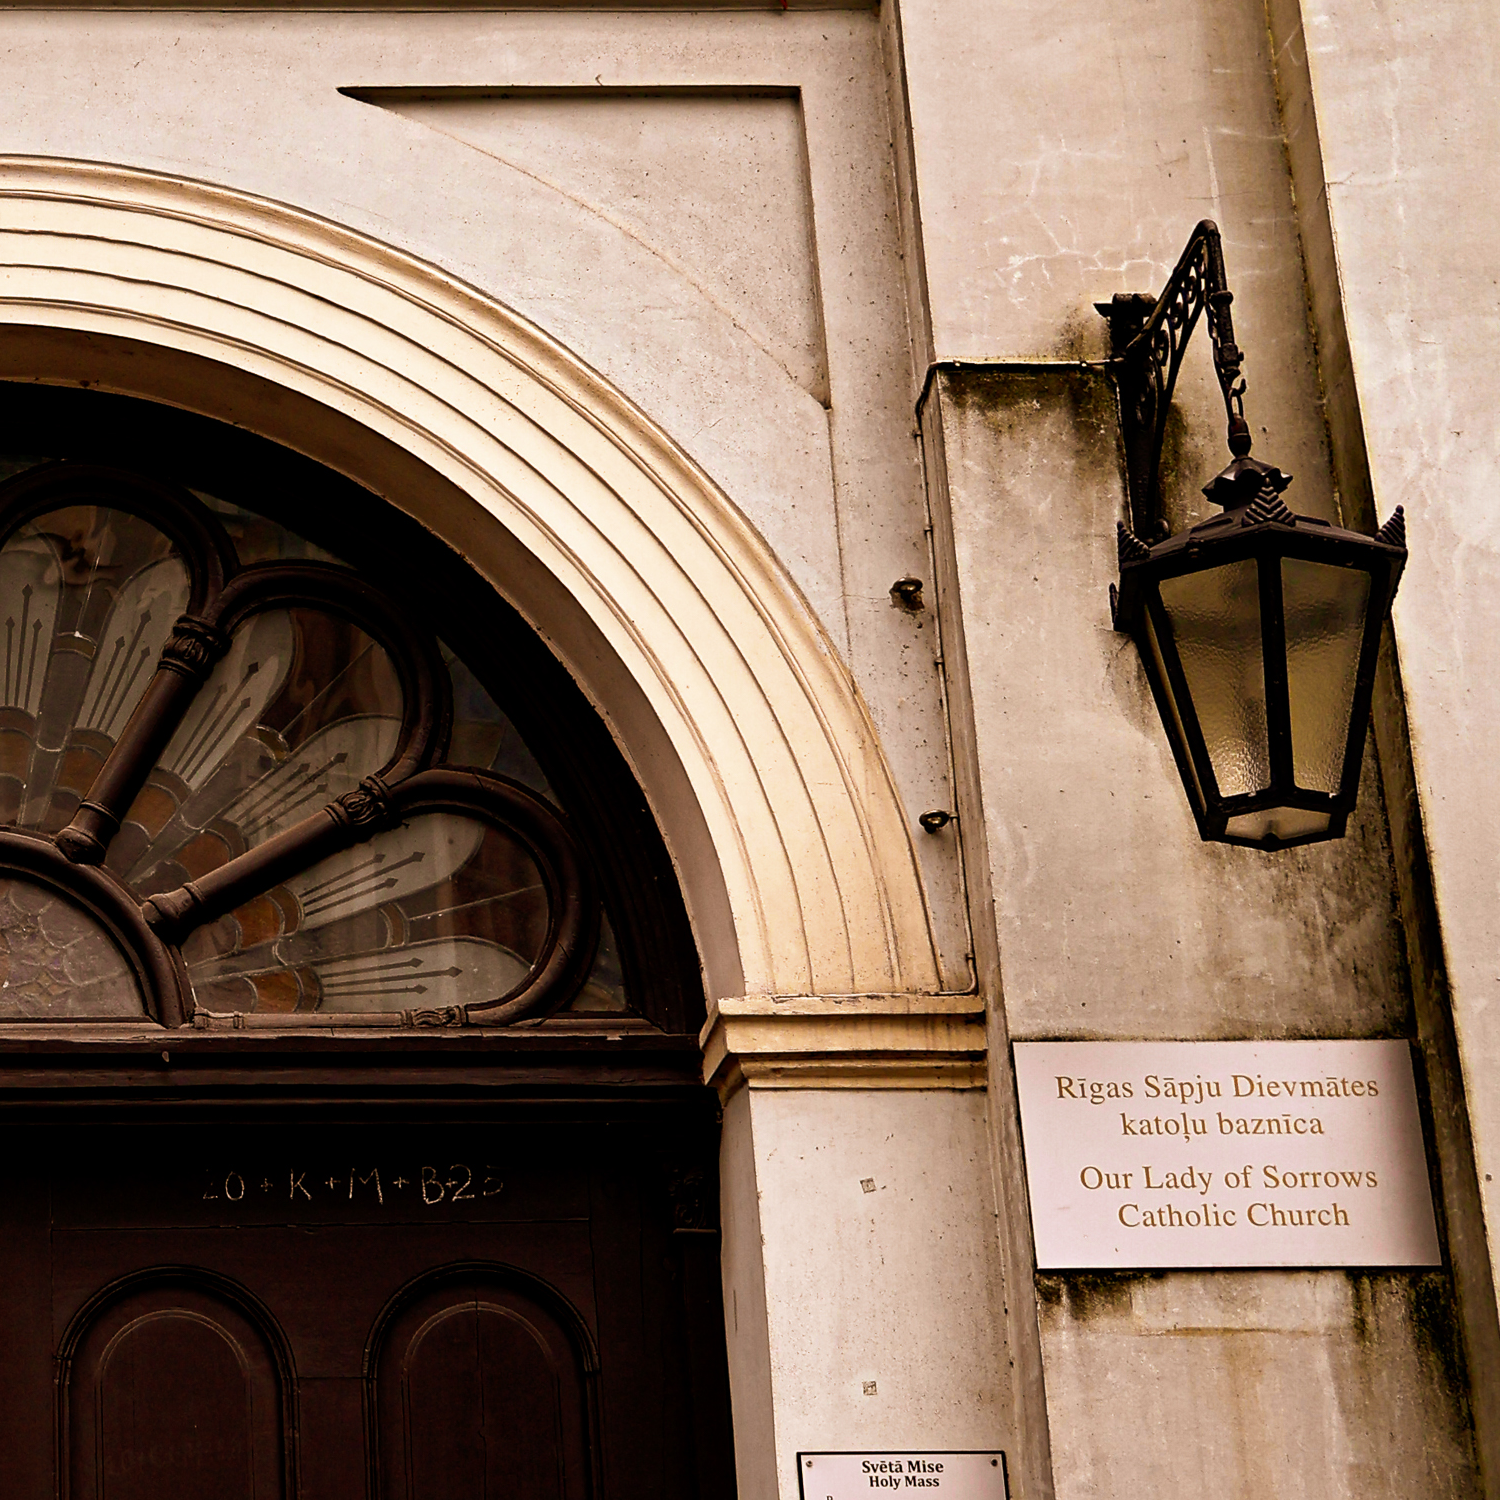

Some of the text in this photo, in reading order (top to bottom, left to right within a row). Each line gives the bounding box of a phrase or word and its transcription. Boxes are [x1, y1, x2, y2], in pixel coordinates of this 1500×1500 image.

[1055, 1072, 1381, 1104] Rīgas Sāpju Dievmātes
[1120, 1112, 1324, 1143] katoļu baznīca
[1080, 1165, 1378, 1195] Our Lady of Sorrows
[1119, 1203, 1350, 1227] Catholic Church
[862, 1460, 943, 1473] Svētā Mise
[869, 1476, 939, 1490] Holy Mass
